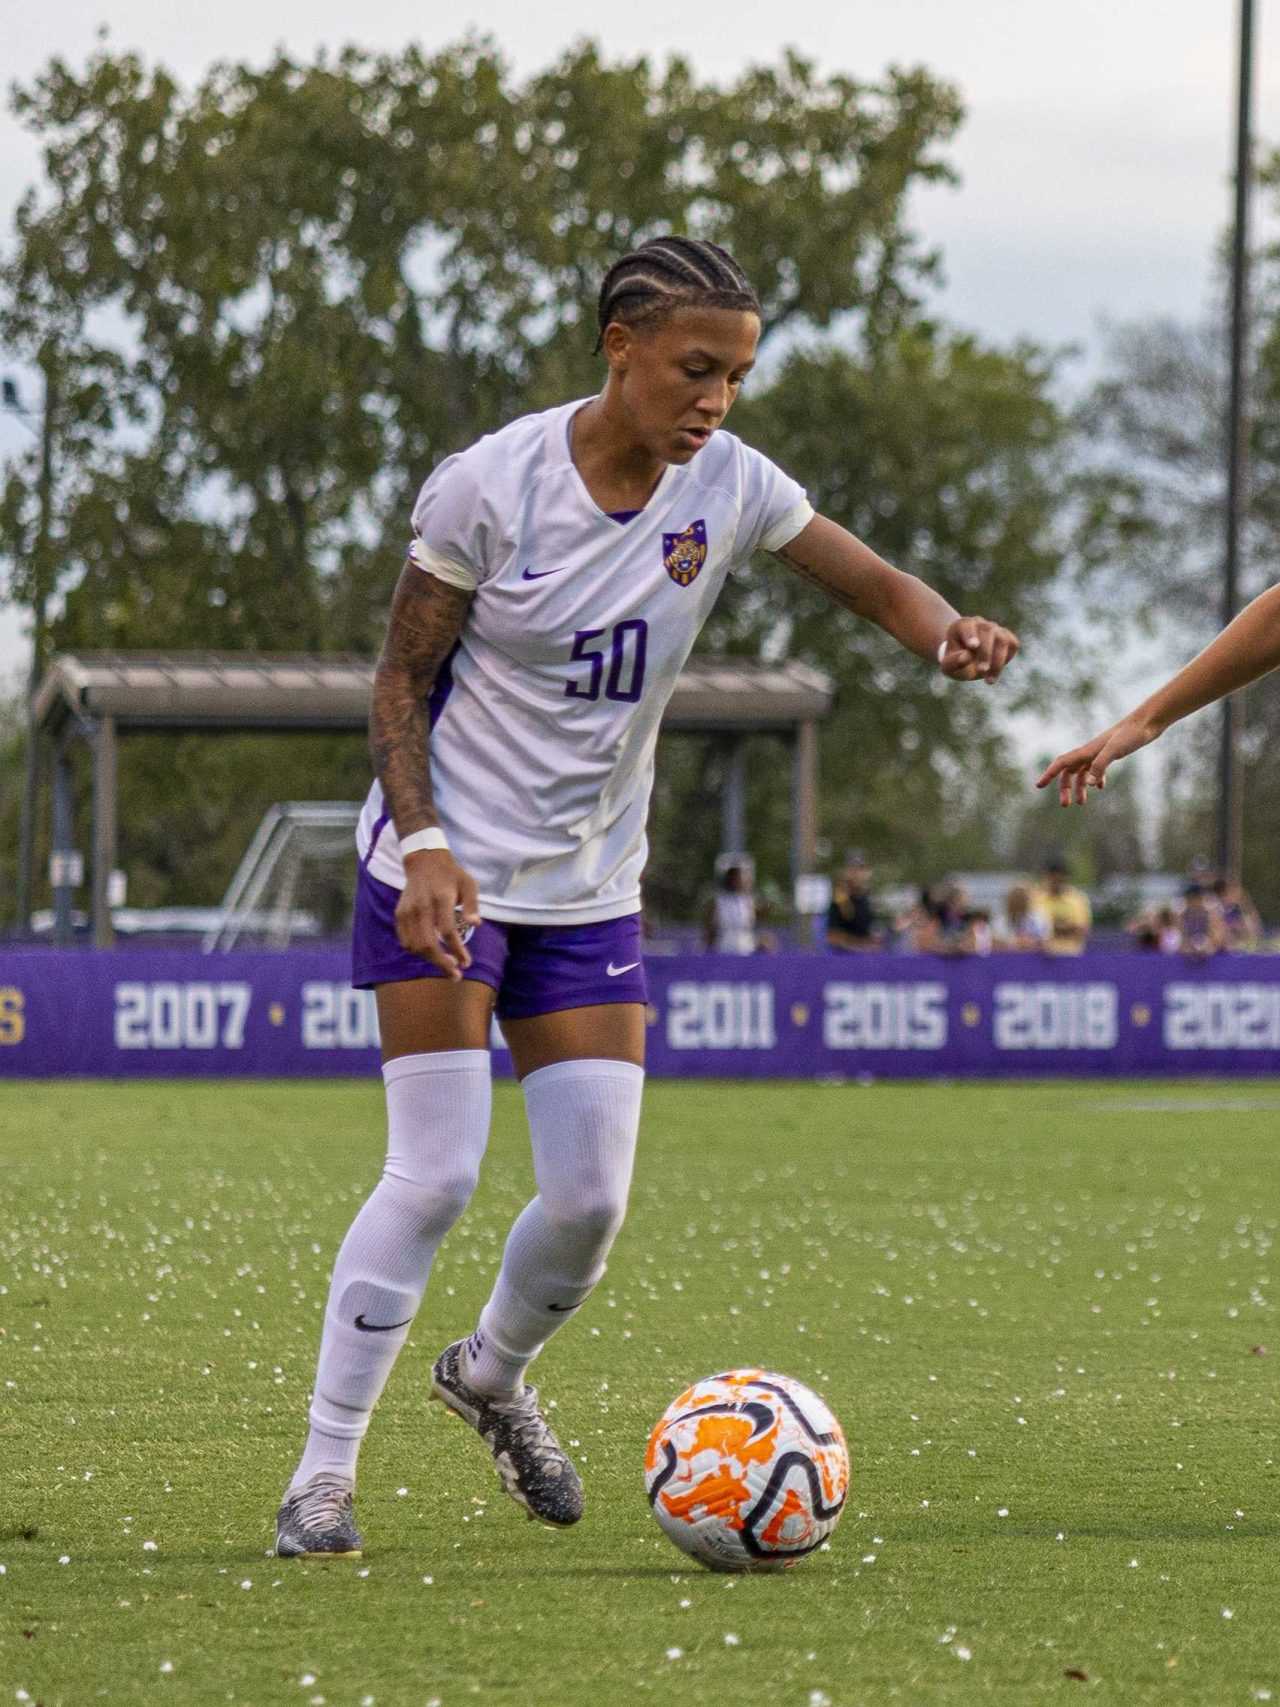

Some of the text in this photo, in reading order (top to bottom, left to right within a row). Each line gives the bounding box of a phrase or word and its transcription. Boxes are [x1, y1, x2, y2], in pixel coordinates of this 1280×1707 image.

[564, 619, 648, 703] 50
[115, 983, 251, 1049] 2007
[302, 982, 382, 1049] 20
[667, 983, 775, 1049] 2011
[823, 983, 948, 1049] 2015
